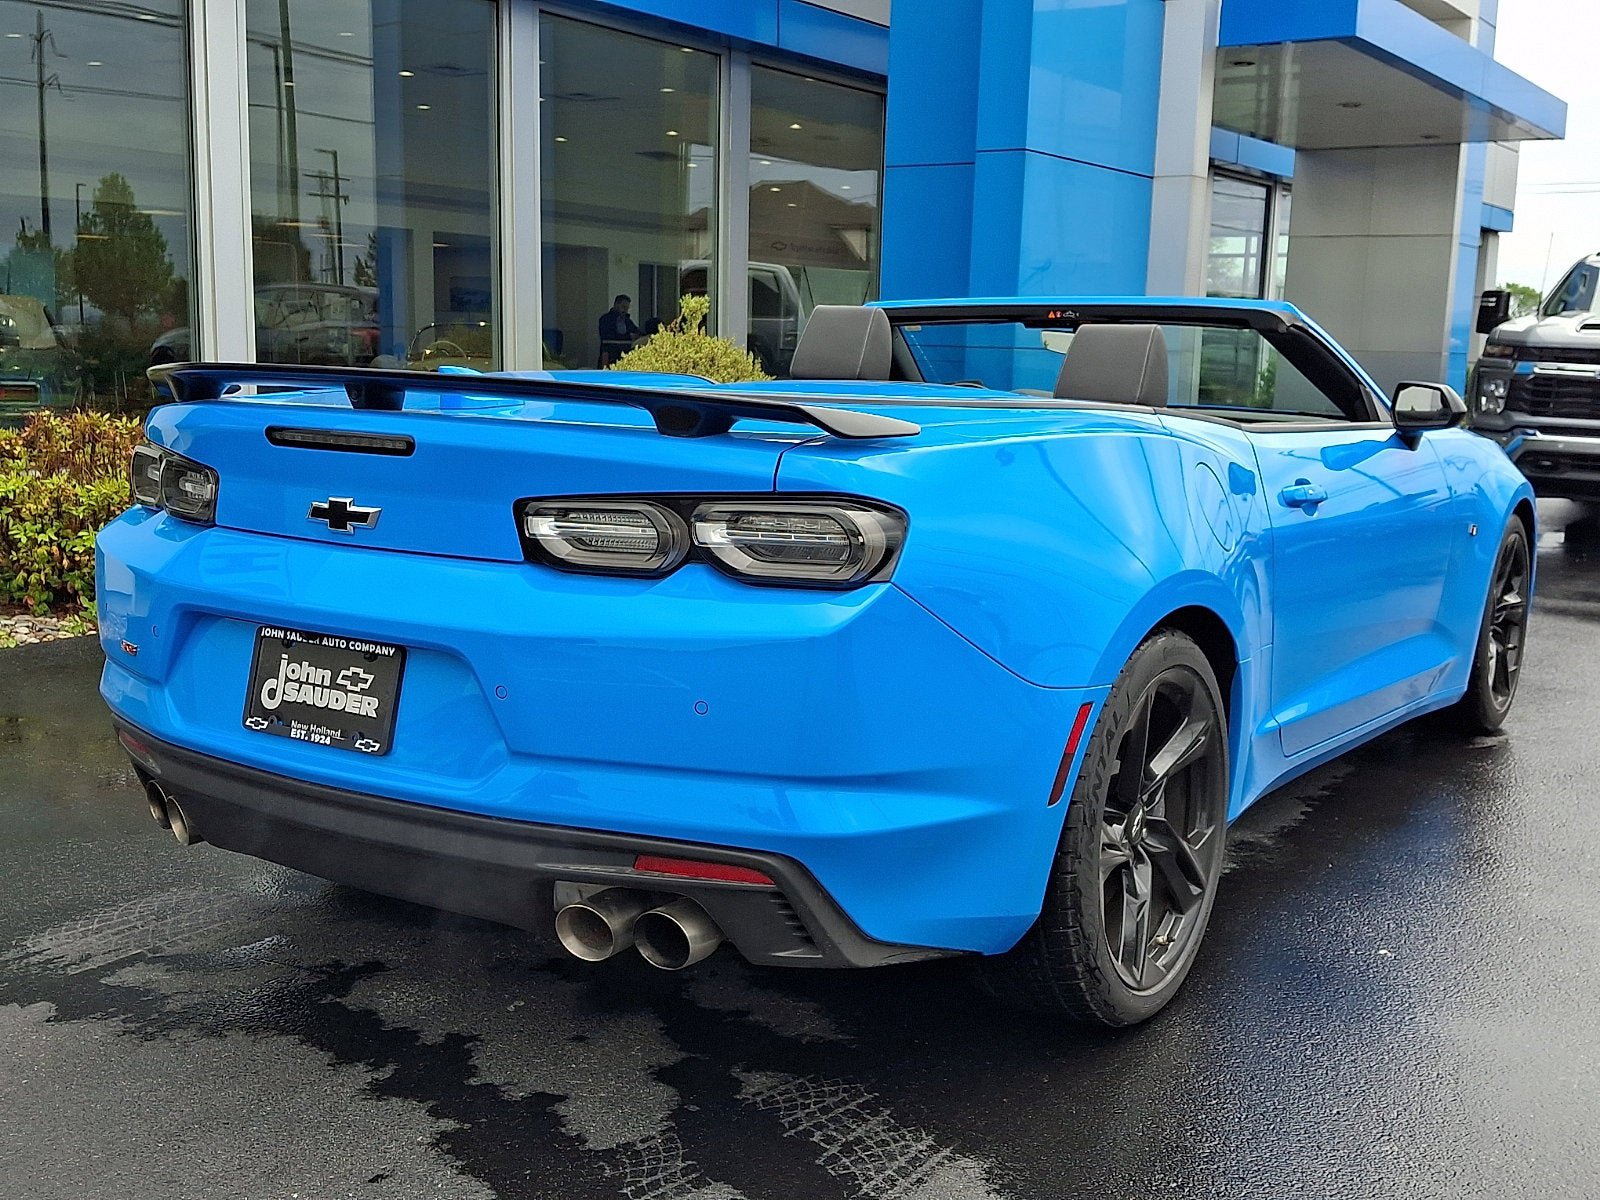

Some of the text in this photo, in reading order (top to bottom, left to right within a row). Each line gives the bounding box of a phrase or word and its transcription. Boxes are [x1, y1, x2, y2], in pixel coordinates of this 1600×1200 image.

[261, 627, 396, 657] JOHN SAU AUTO COMPANY
[283, 682, 379, 718] SAUDER
[290, 720, 341, 738] New Holland
[290, 728, 331, 745] EST. 1924
